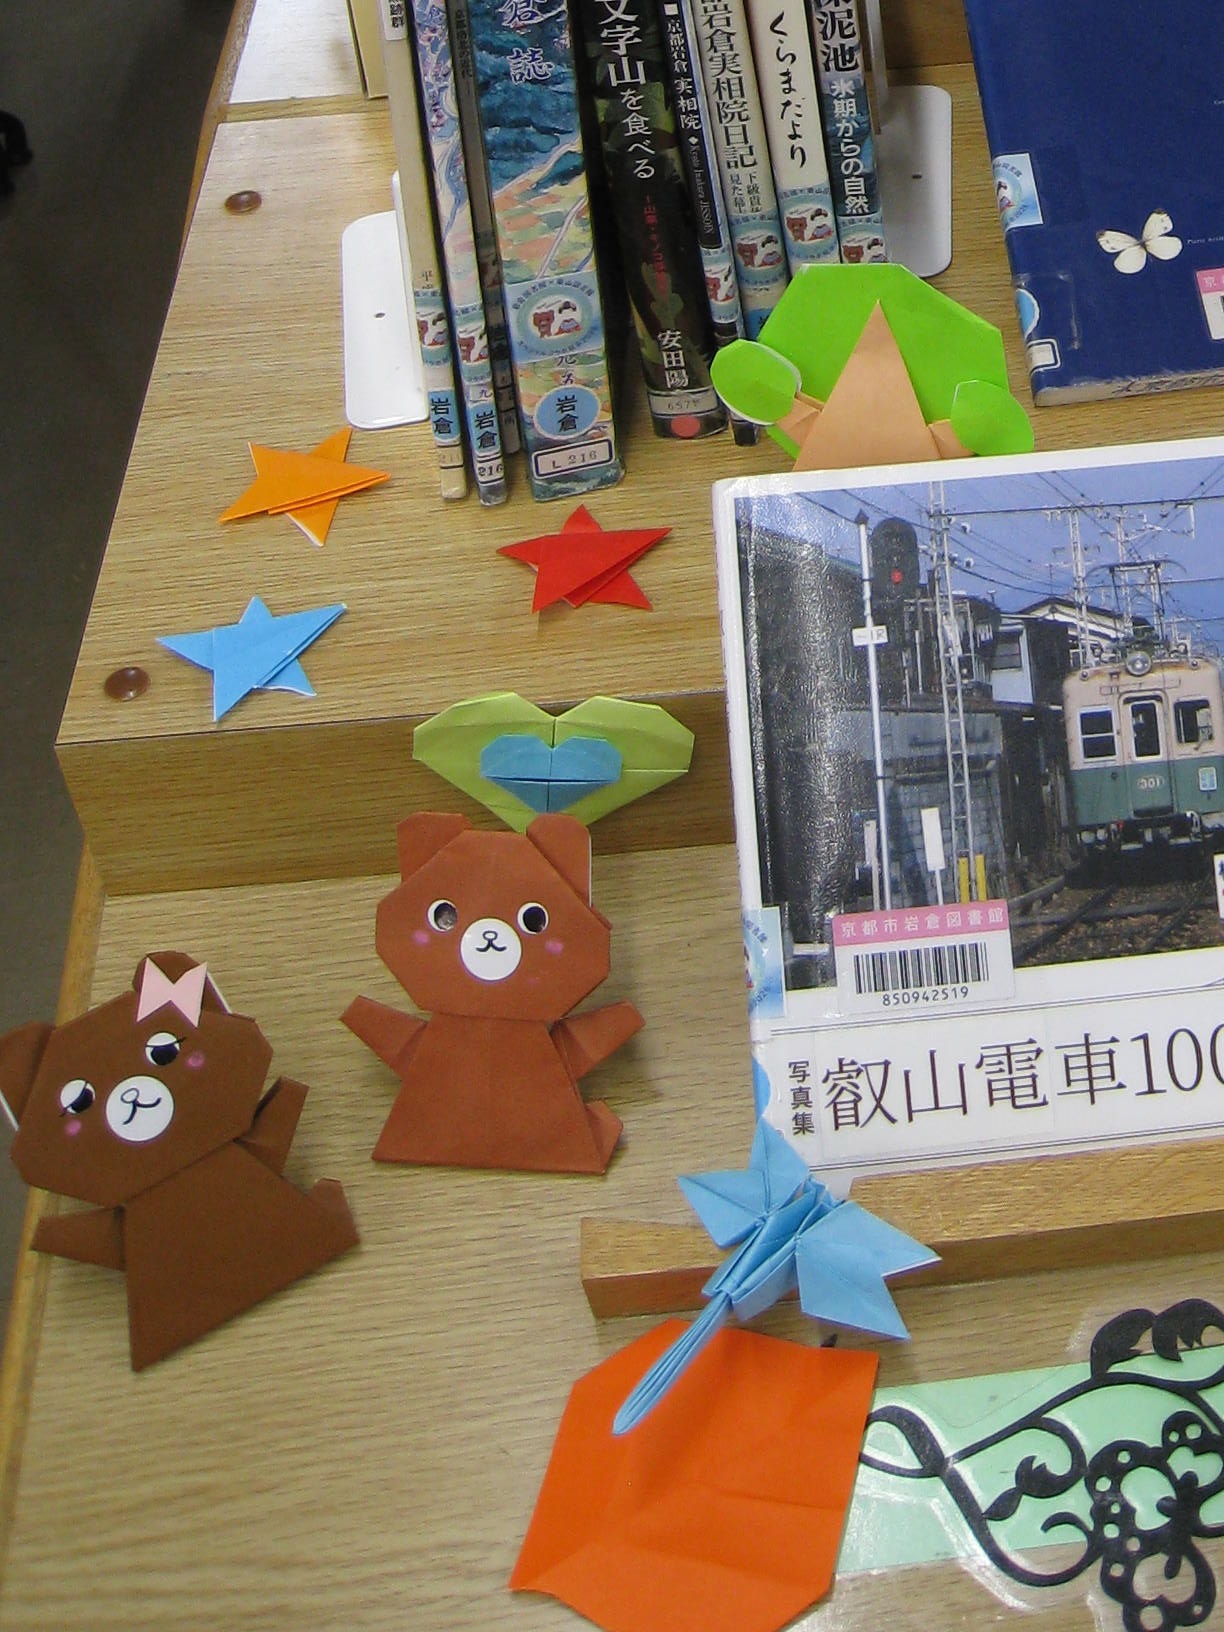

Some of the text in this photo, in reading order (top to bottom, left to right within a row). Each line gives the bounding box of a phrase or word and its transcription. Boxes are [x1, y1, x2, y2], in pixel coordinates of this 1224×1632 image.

[831, 78, 870, 214] 氷期からの自然
[431, 397, 454, 434] 岩倉
[474, 411, 498, 449] 岩倉
[555, 394, 579, 432] 岩倉
[841, 907, 1004, 939] 京都市岩倉図書館
[882, 985, 970, 1007] 850942519
[788, 1060, 815, 1136] 写真集
